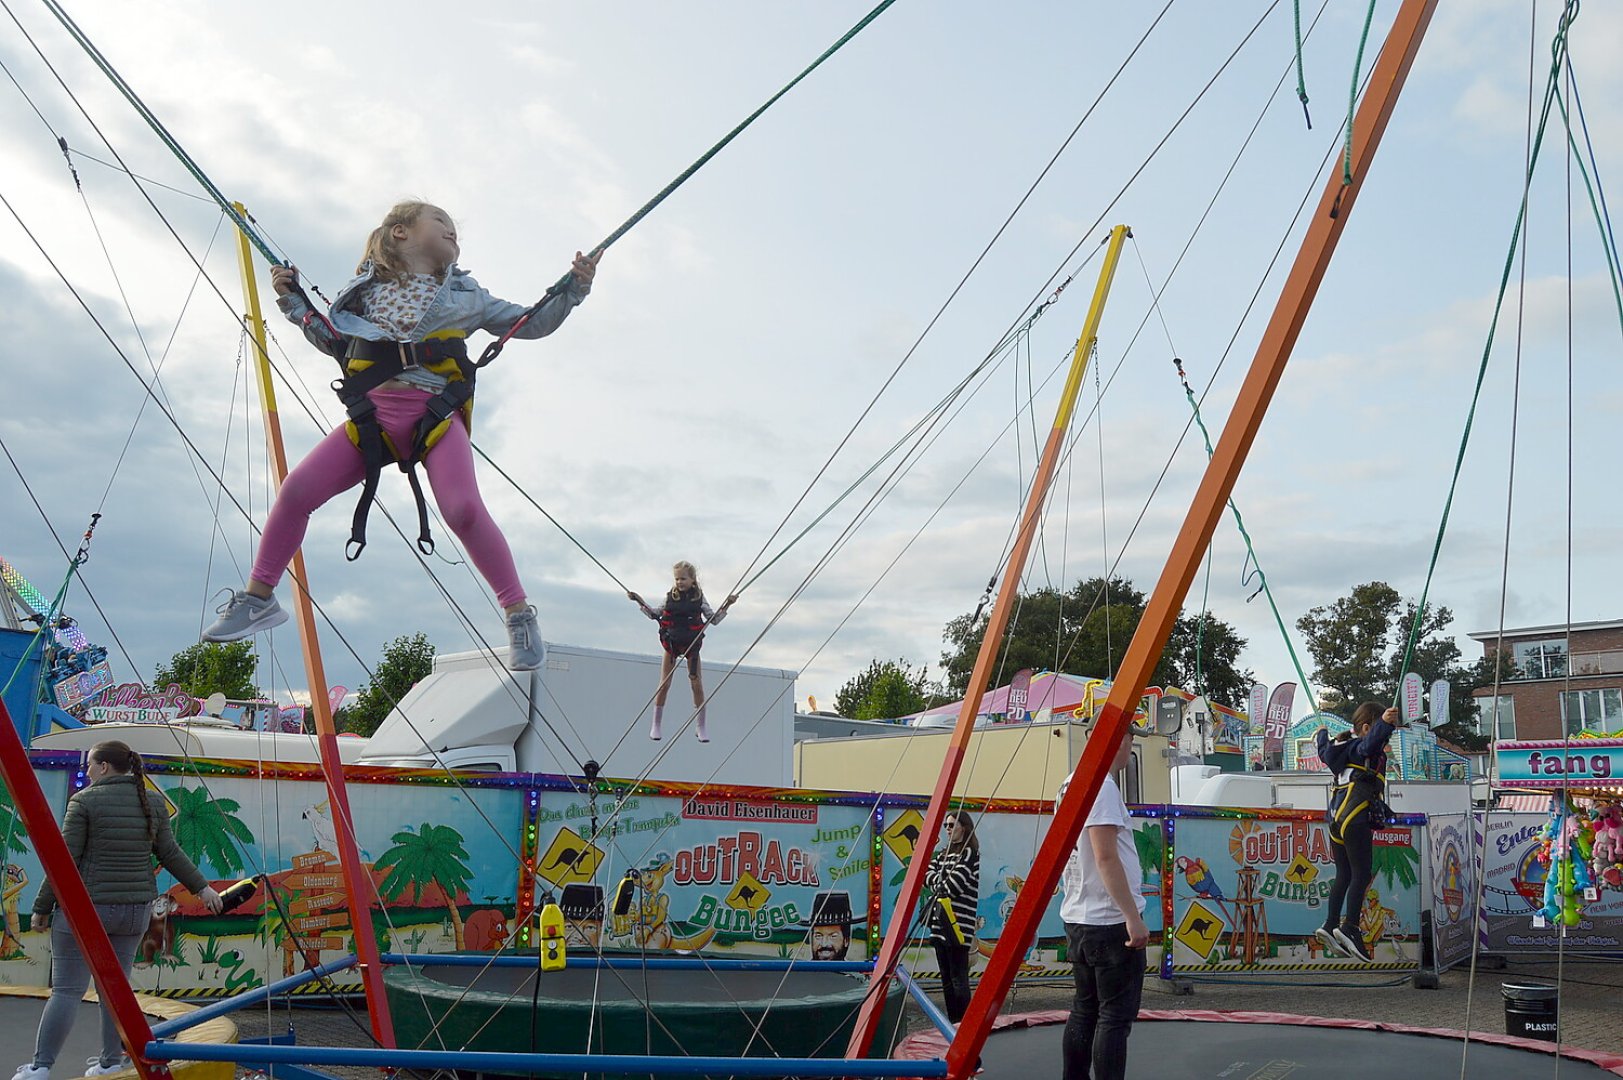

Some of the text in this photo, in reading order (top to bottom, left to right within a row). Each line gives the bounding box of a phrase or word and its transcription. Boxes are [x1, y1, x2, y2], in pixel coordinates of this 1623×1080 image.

[1406, 678, 1420, 718] FUNCITY
[1528, 752, 1611, 778] fang
[687, 800, 814, 820] David Eisenhauer
[811, 824, 861, 843] Jump
[1245, 821, 1335, 864] OUTBA
[1372, 831, 1410, 844] Ausgang
[674, 831, 819, 886] OUTBACK
[836, 845, 849, 859] &
[829, 858, 871, 881] Smile
[303, 876, 337, 888] Oldenburg
[300, 916, 331, 929] Hamburg
[688, 894, 801, 938] Bungee
[1525, 1023, 1557, 1031] PLASTIC
